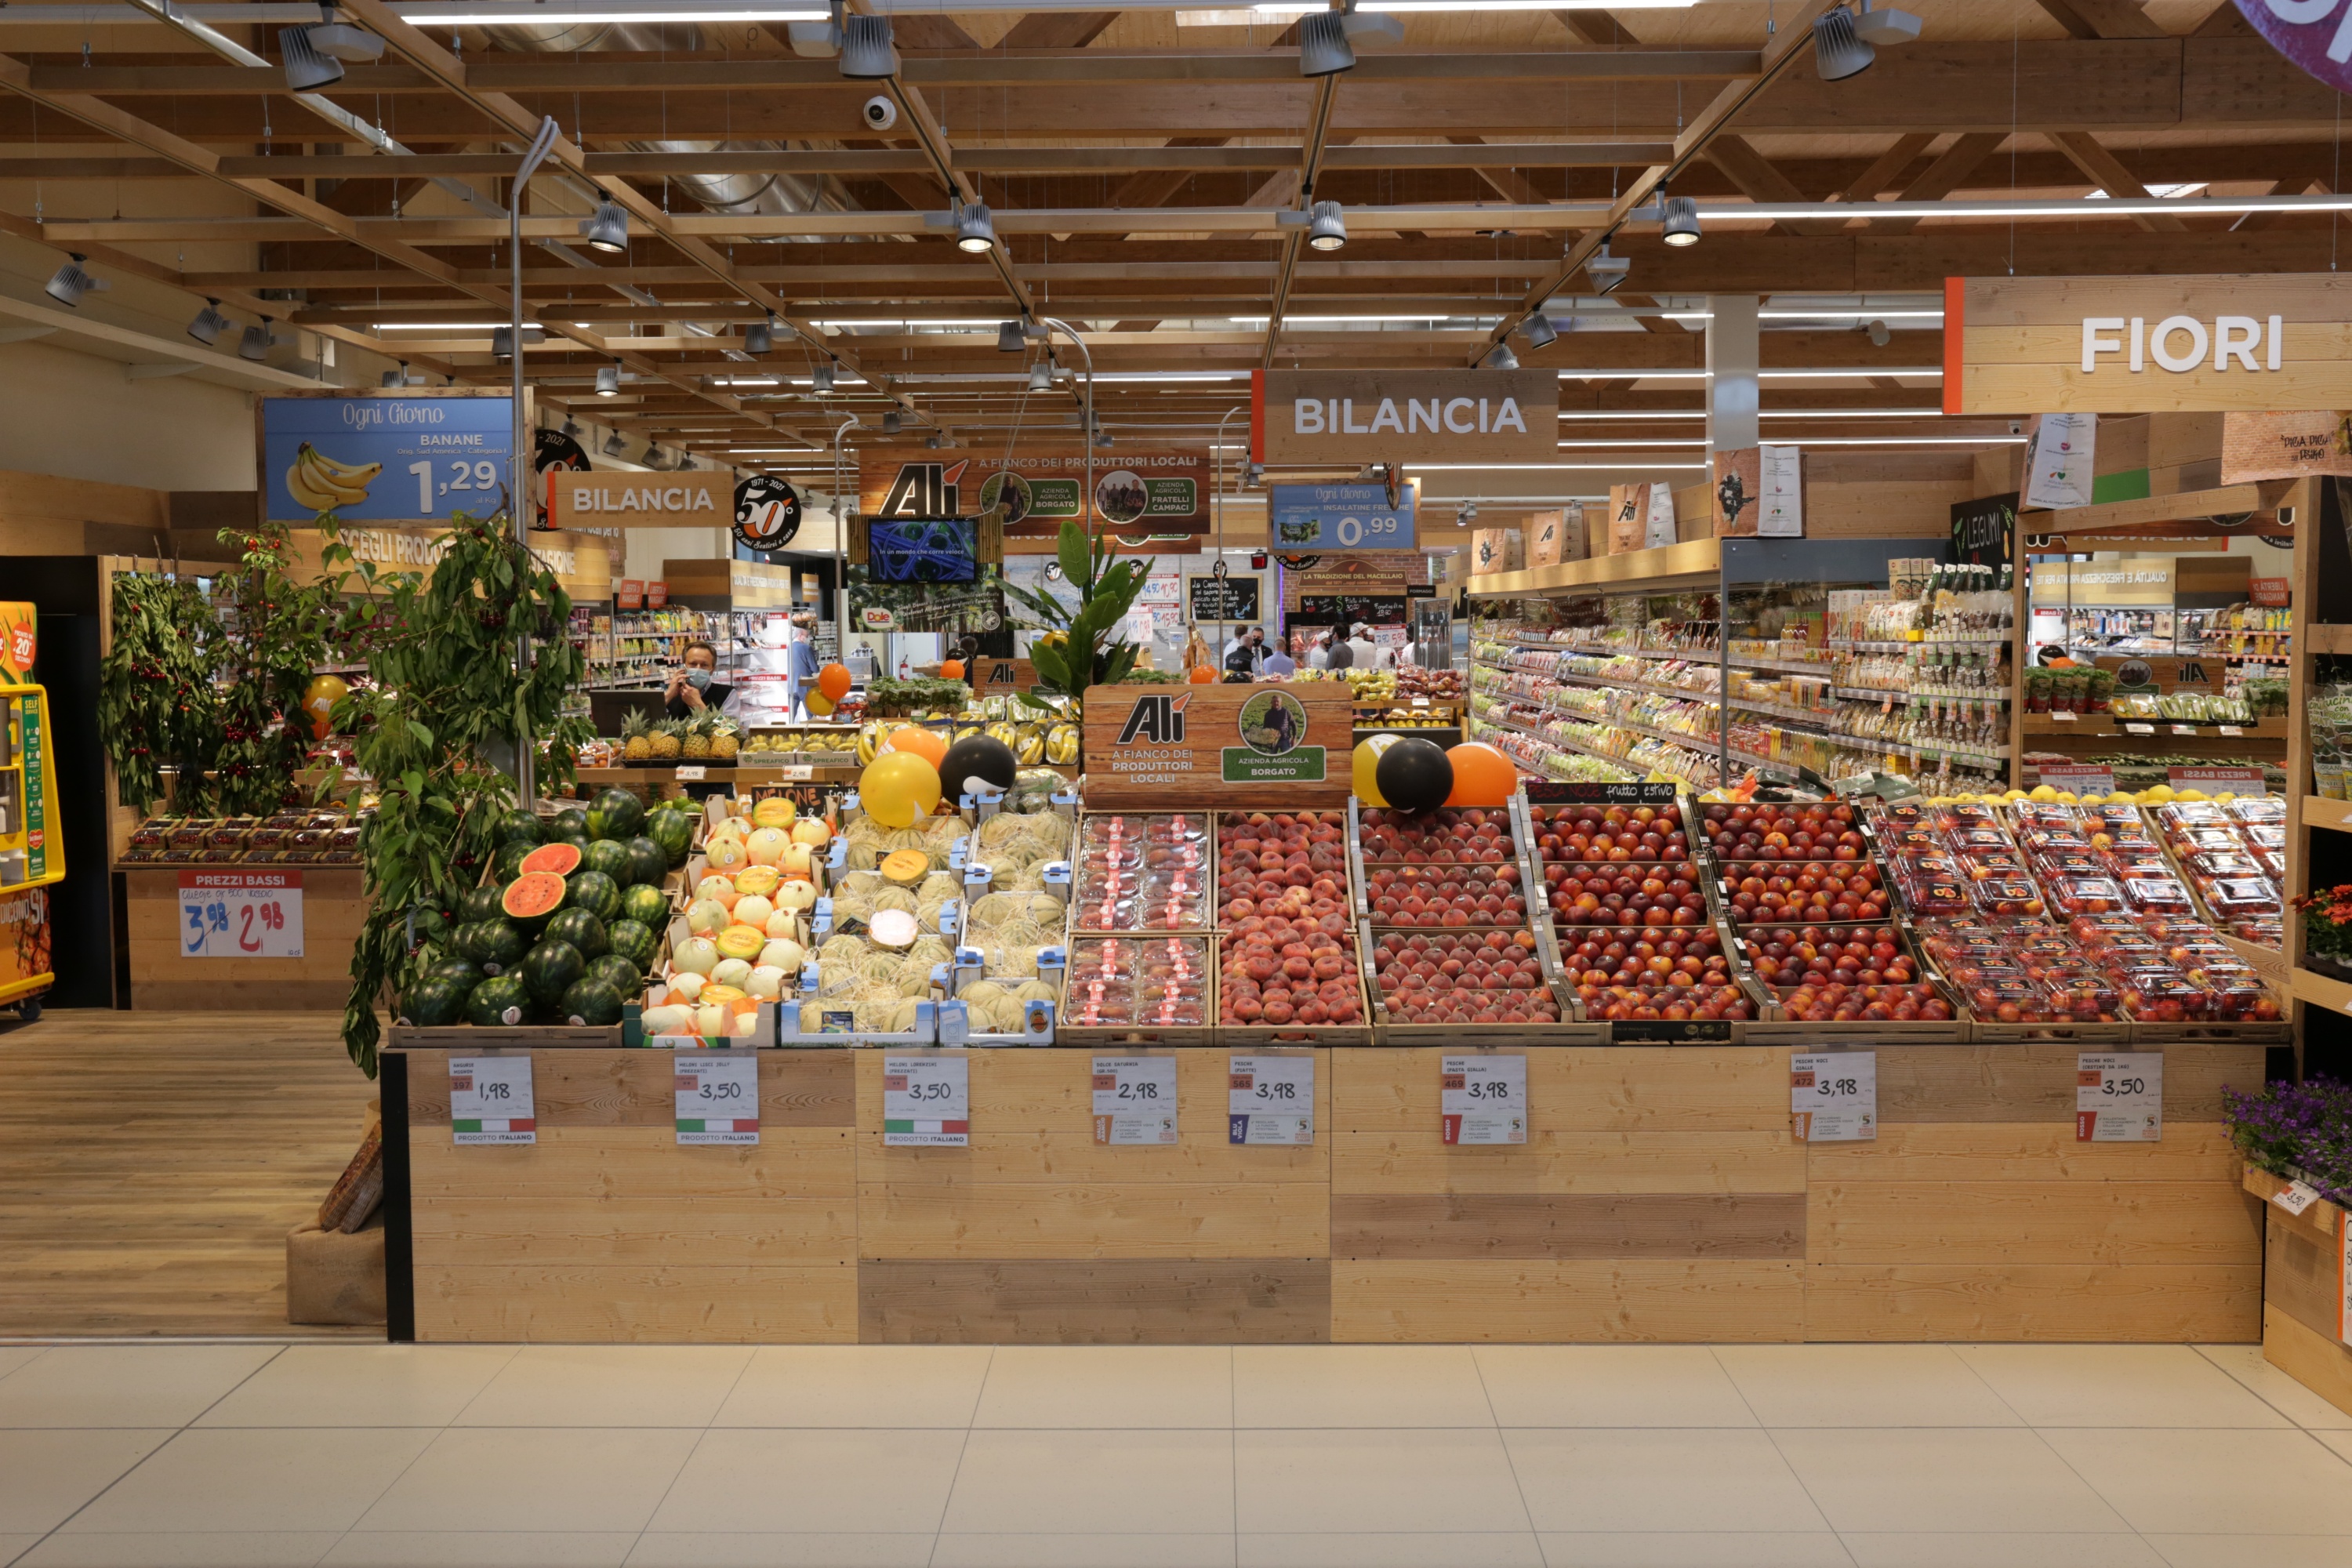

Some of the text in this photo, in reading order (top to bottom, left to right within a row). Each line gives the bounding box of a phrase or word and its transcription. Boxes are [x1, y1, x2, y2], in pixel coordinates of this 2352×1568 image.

[2082, 315, 2282, 372] FIORI
[343, 403, 445, 430] Ogni Giorno
[1294, 397, 1527, 434] BILANCIA
[420, 434, 483, 446] BANANE
[546, 434, 565, 447] 2021
[992, 459, 1037, 467] FIANCO
[1042, 458, 1061, 467] DEI
[1065, 457, 1147, 467] PRODUTTORI
[1152, 457, 1196, 466] LOCALI
[409, 460, 496, 514] 1,29
[751, 477, 785, 491] 1971 2021
[485, 497, 496, 506] Kg
[573, 488, 714, 510] BILANCIA
[1316, 488, 1370, 503] Ogni Giorno
[1337, 517, 1397, 546] 0,99
[1967, 512, 2000, 549] LEGUMI
[867, 612, 890, 621] Dole
[25, 699, 38, 709] SELF
[1124, 750, 1169, 759] FIANCO
[1174, 750, 1192, 758] DEI
[1112, 761, 1192, 771] PRODUTTORI
[1131, 774, 1175, 783] LOCALI
[1529, 785, 1673, 798] PESCA NOCE frutto estivo
[196, 876, 285, 885] PREZZI BASSI
[228, 889, 243, 898] 500
[480, 1083, 510, 1102] 1,98
[699, 1082, 741, 1102] 3,50
[909, 1083, 950, 1102] 3,50
[1118, 1083, 1158, 1101] 2,98
[1256, 1083, 1295, 1101] 3,98
[1468, 1082, 1508, 1100] 3,98
[1817, 1079, 1857, 1097] 3,98
[2102, 1078, 2144, 1097] 3,50
[1163, 1120, 1171, 1129] 5
[1299, 1120, 1307, 1130] 5
[1512, 1120, 1520, 1129] 5
[1862, 1115, 1871, 1124] 5
[2147, 1116, 2154, 1127] 5
[2286, 1191, 2307, 1207] 3,50
